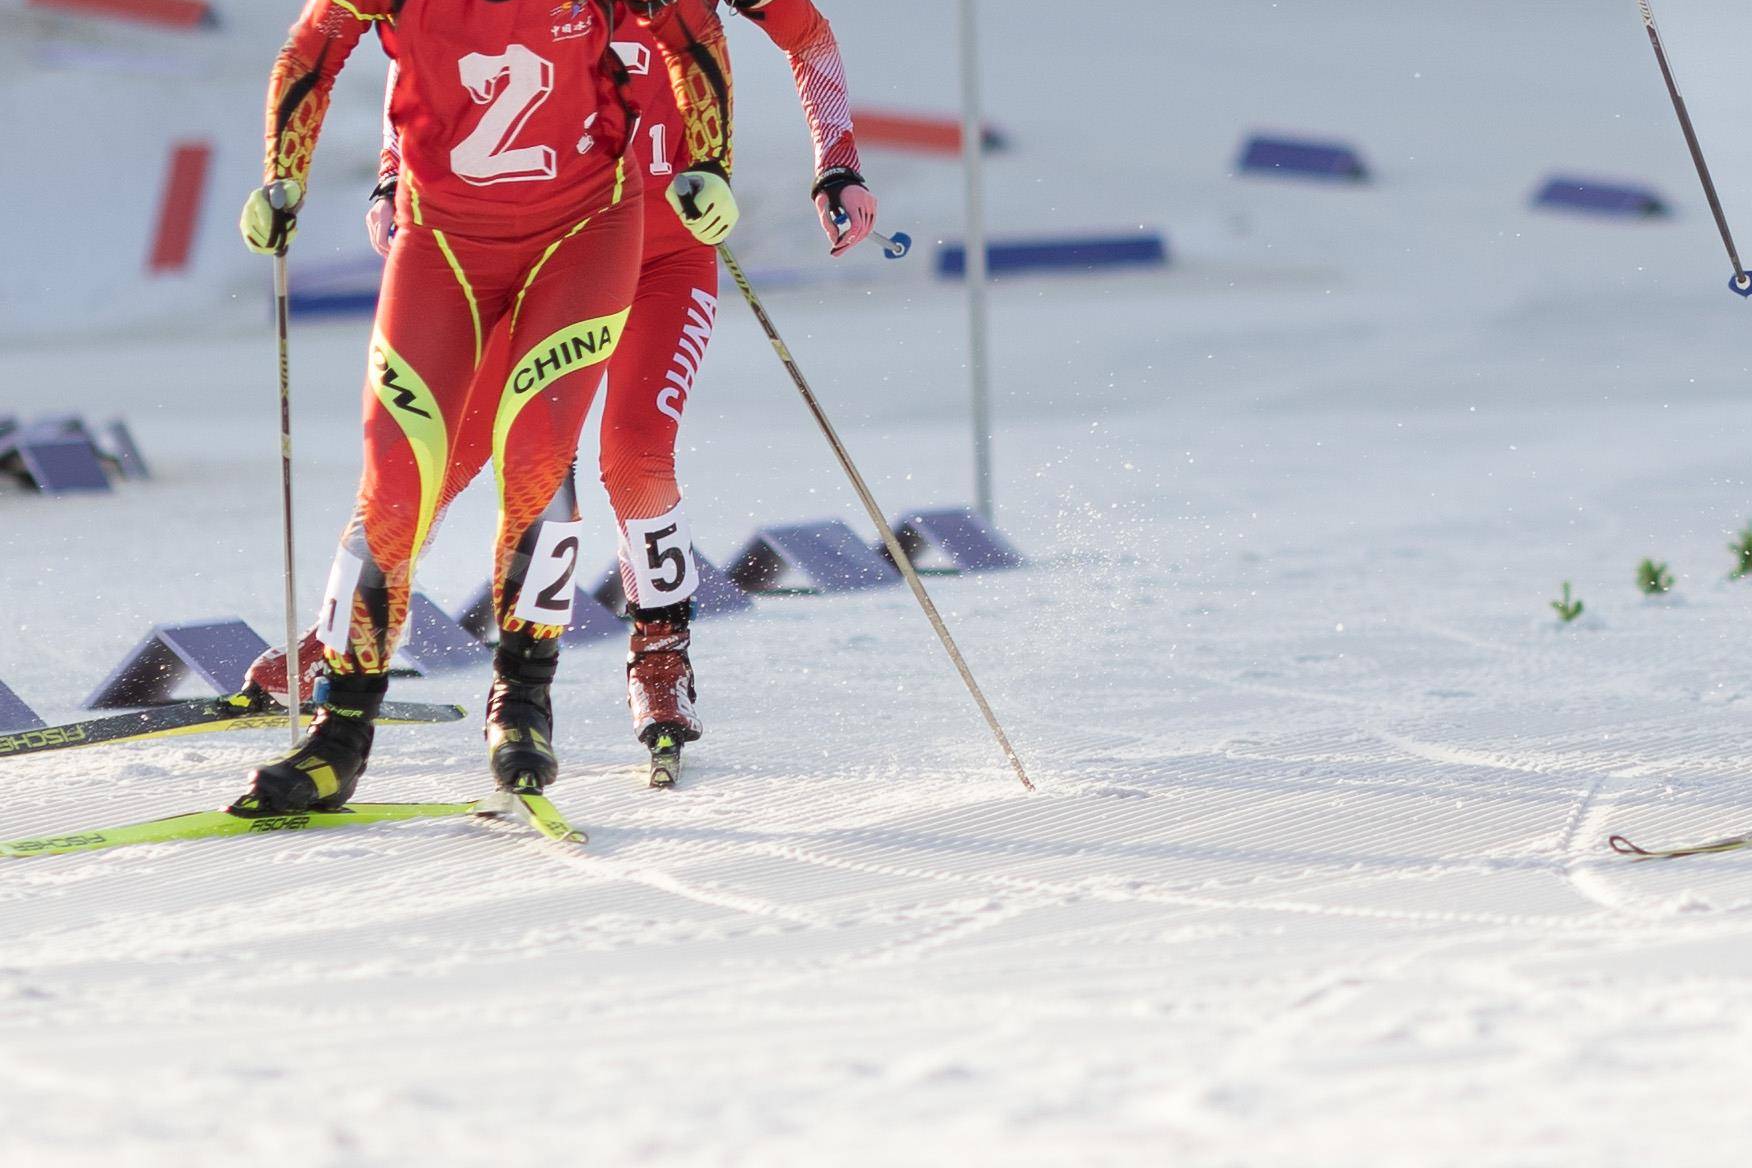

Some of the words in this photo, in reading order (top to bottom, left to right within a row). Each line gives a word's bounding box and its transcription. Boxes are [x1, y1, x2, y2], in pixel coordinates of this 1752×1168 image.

[449, 44, 557, 187] 2
[511, 325, 612, 395] CHINA
[655, 287, 719, 421] CHINA
[534, 535, 580, 612] 2
[642, 523, 687, 593] 5
[249, 816, 311, 831] FISCHER
